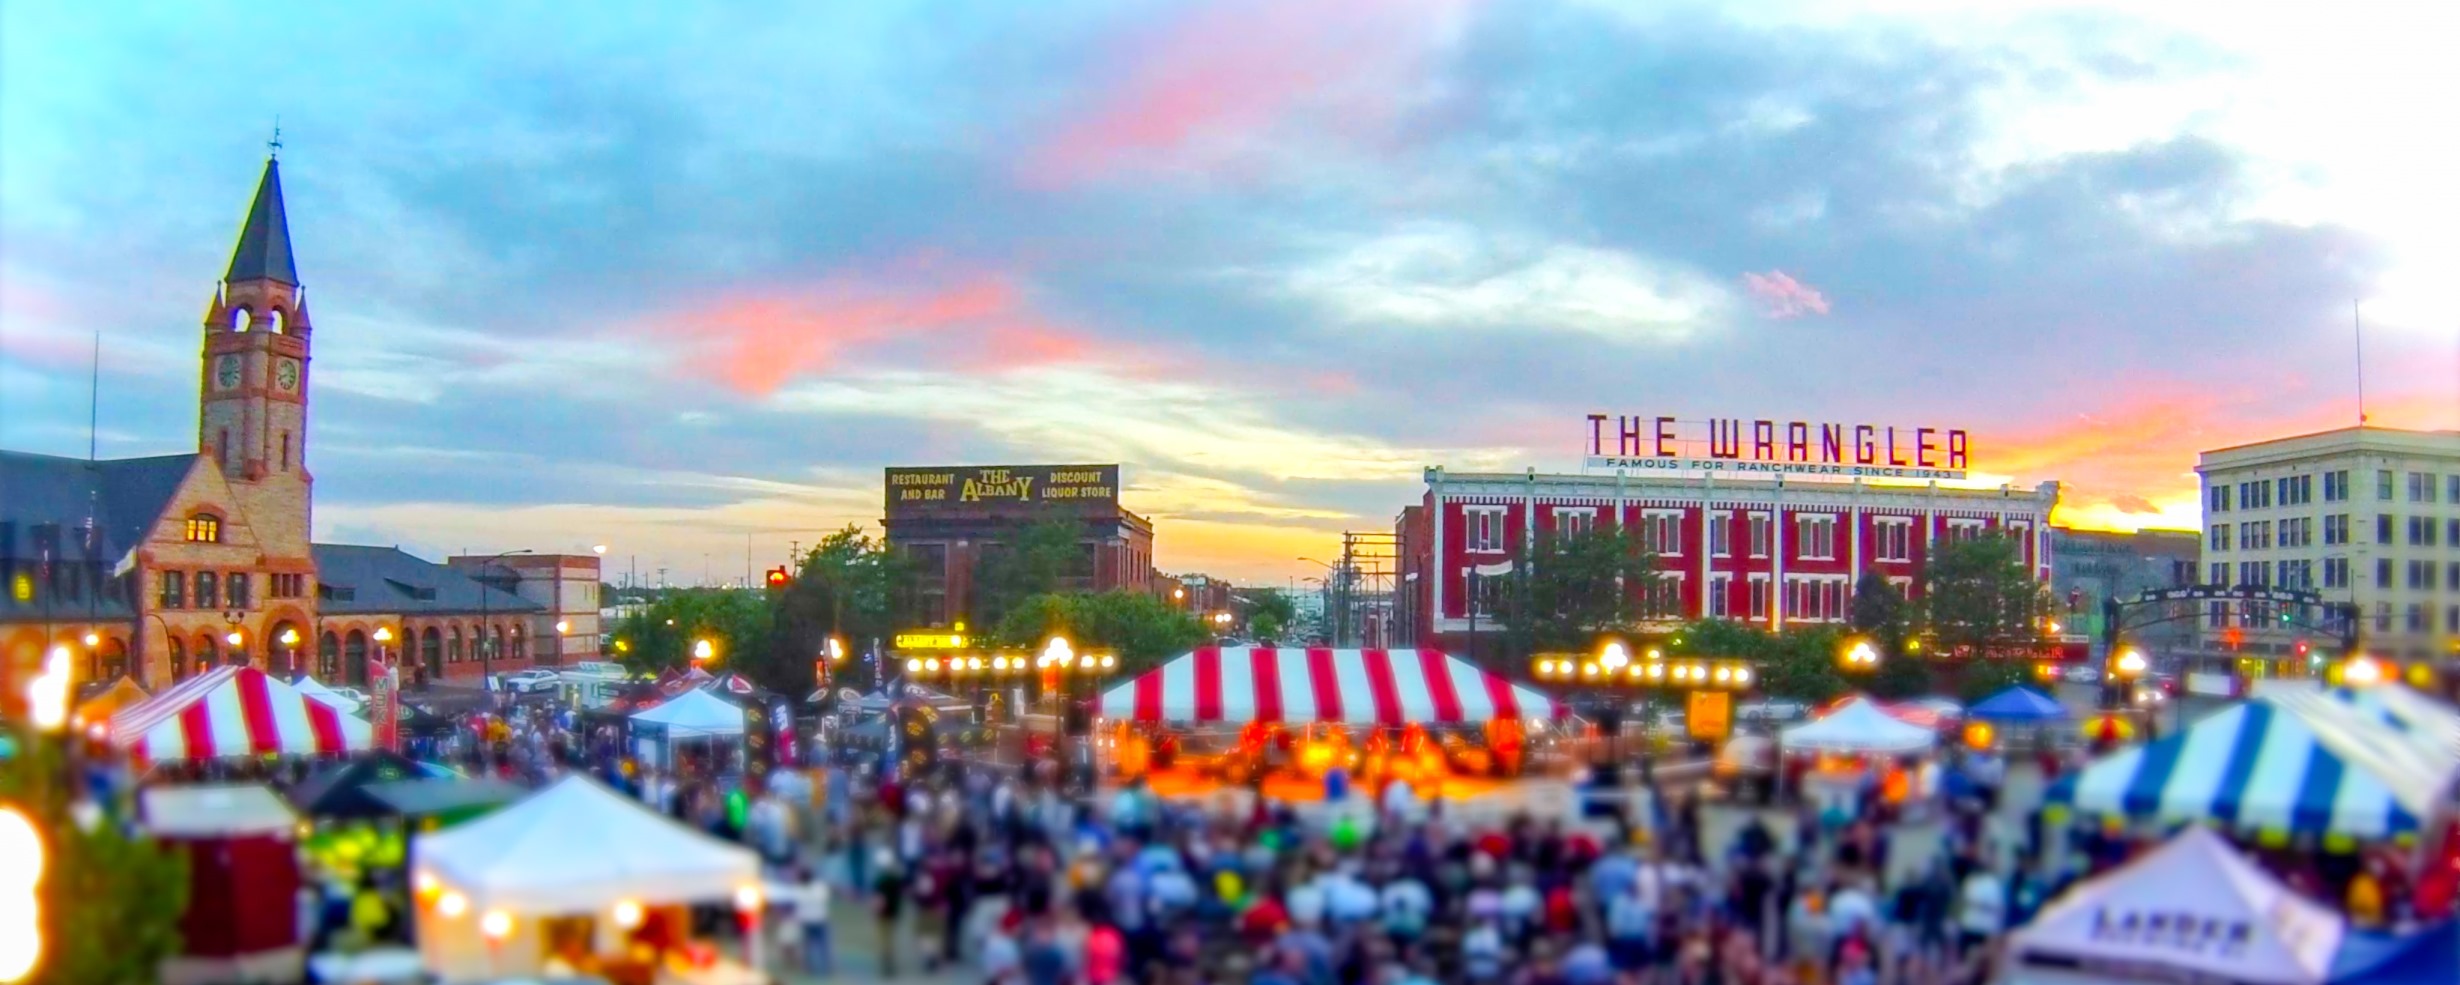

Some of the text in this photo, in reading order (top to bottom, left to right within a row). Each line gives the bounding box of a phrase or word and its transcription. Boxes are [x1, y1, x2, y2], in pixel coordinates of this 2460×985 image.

[1587, 414, 1967, 469] THE WRANGLER
[1606, 458, 1952, 479] FAMOUS FOR RANCHWEAR SINCE 1943
[891, 473, 956, 486] RESTAURANT
[979, 469, 1011, 483] THE
[1050, 471, 1103, 483] DISCOUNT
[901, 488, 946, 500] AND BAR
[960, 476, 1034, 502] ALBANY
[1041, 486, 1112, 499] LIQUOR STORE
